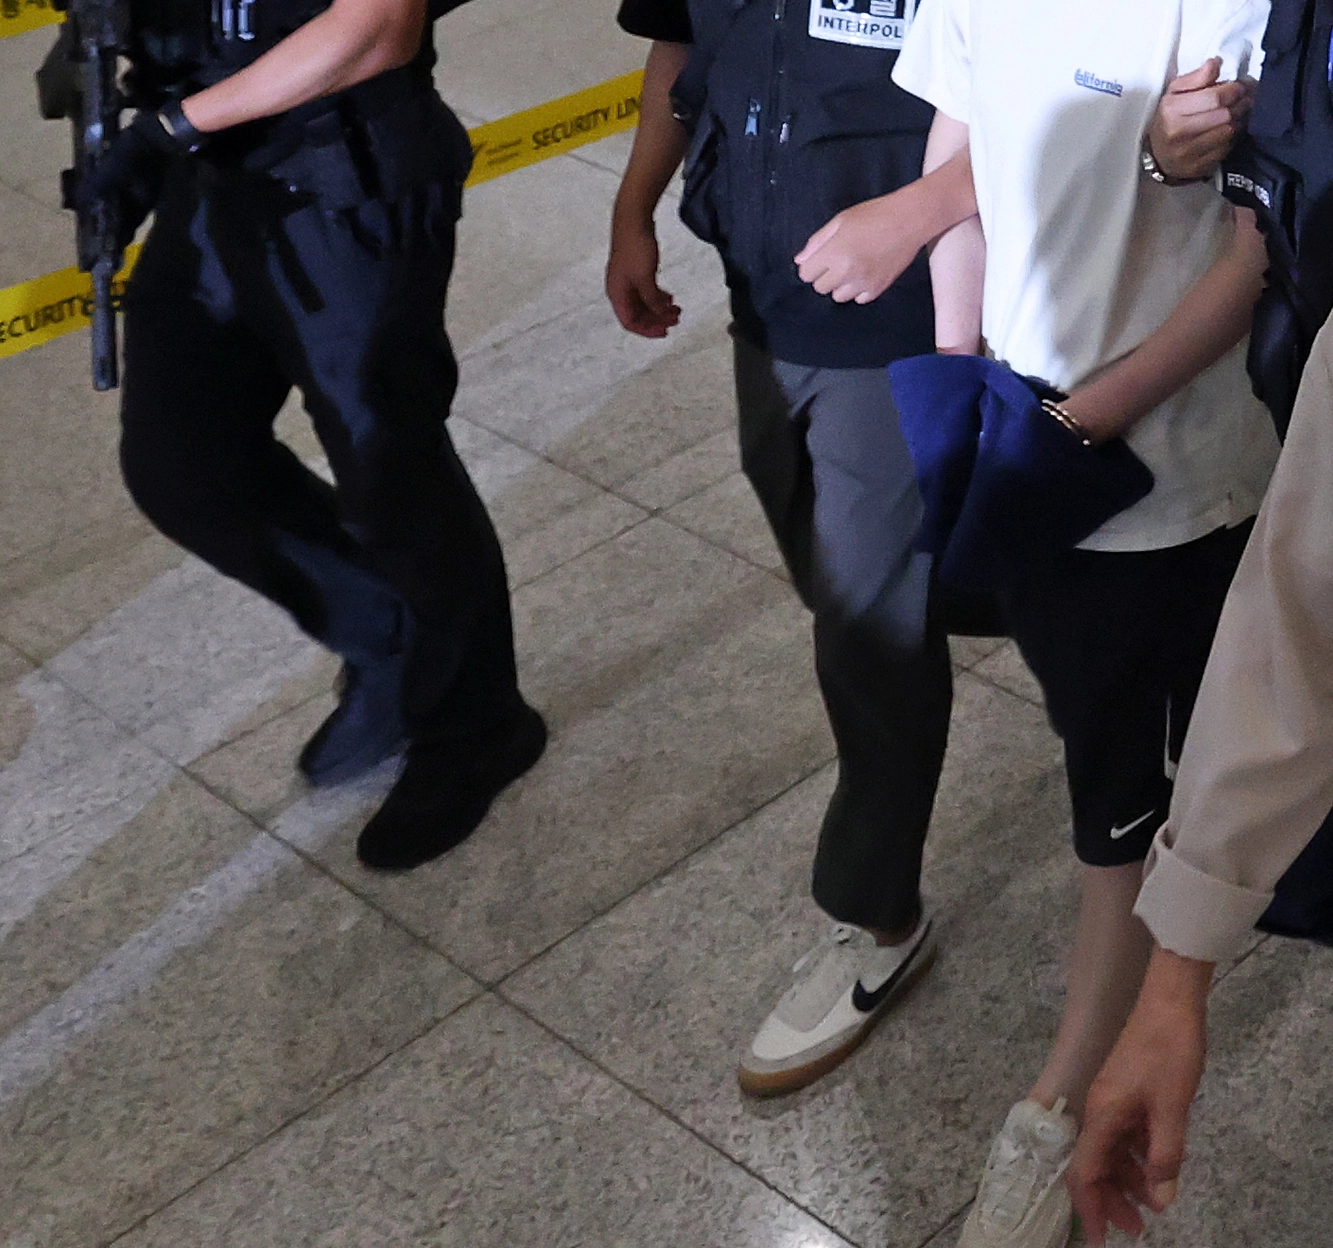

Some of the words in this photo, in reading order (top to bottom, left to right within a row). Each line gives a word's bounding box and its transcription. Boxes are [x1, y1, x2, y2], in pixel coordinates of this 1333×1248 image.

[817, 14, 903, 39] INTERPOL
[532, 105, 611, 151] SECURITY
[617, 95, 642, 121] LIN
